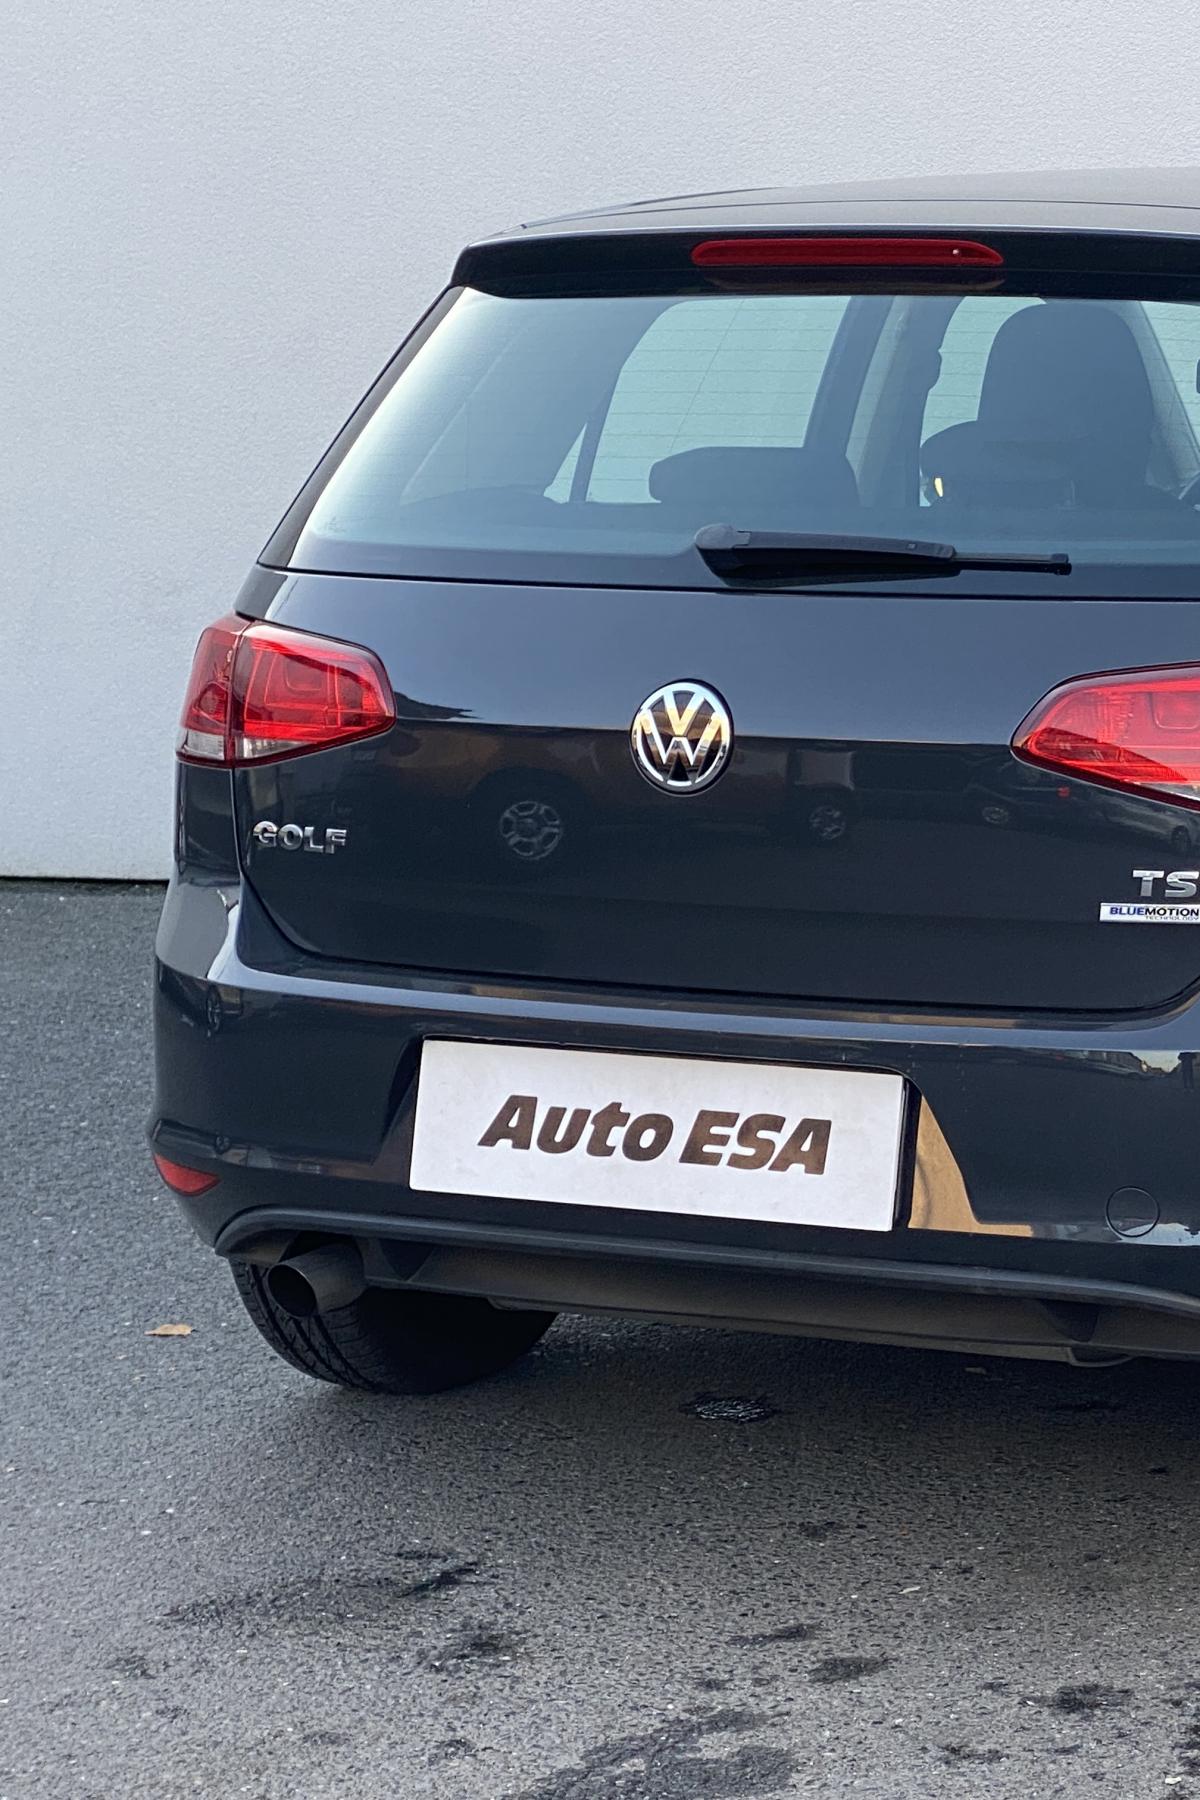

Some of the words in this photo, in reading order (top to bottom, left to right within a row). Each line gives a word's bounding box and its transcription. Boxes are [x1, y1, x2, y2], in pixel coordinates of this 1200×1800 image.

[634, 683, 731, 791] VW
[252, 821, 347, 854] GOLF
[1109, 906, 1200, 917] BLUEMOTION
[477, 1094, 675, 1162] Auto
[679, 1109, 832, 1175] ESA
